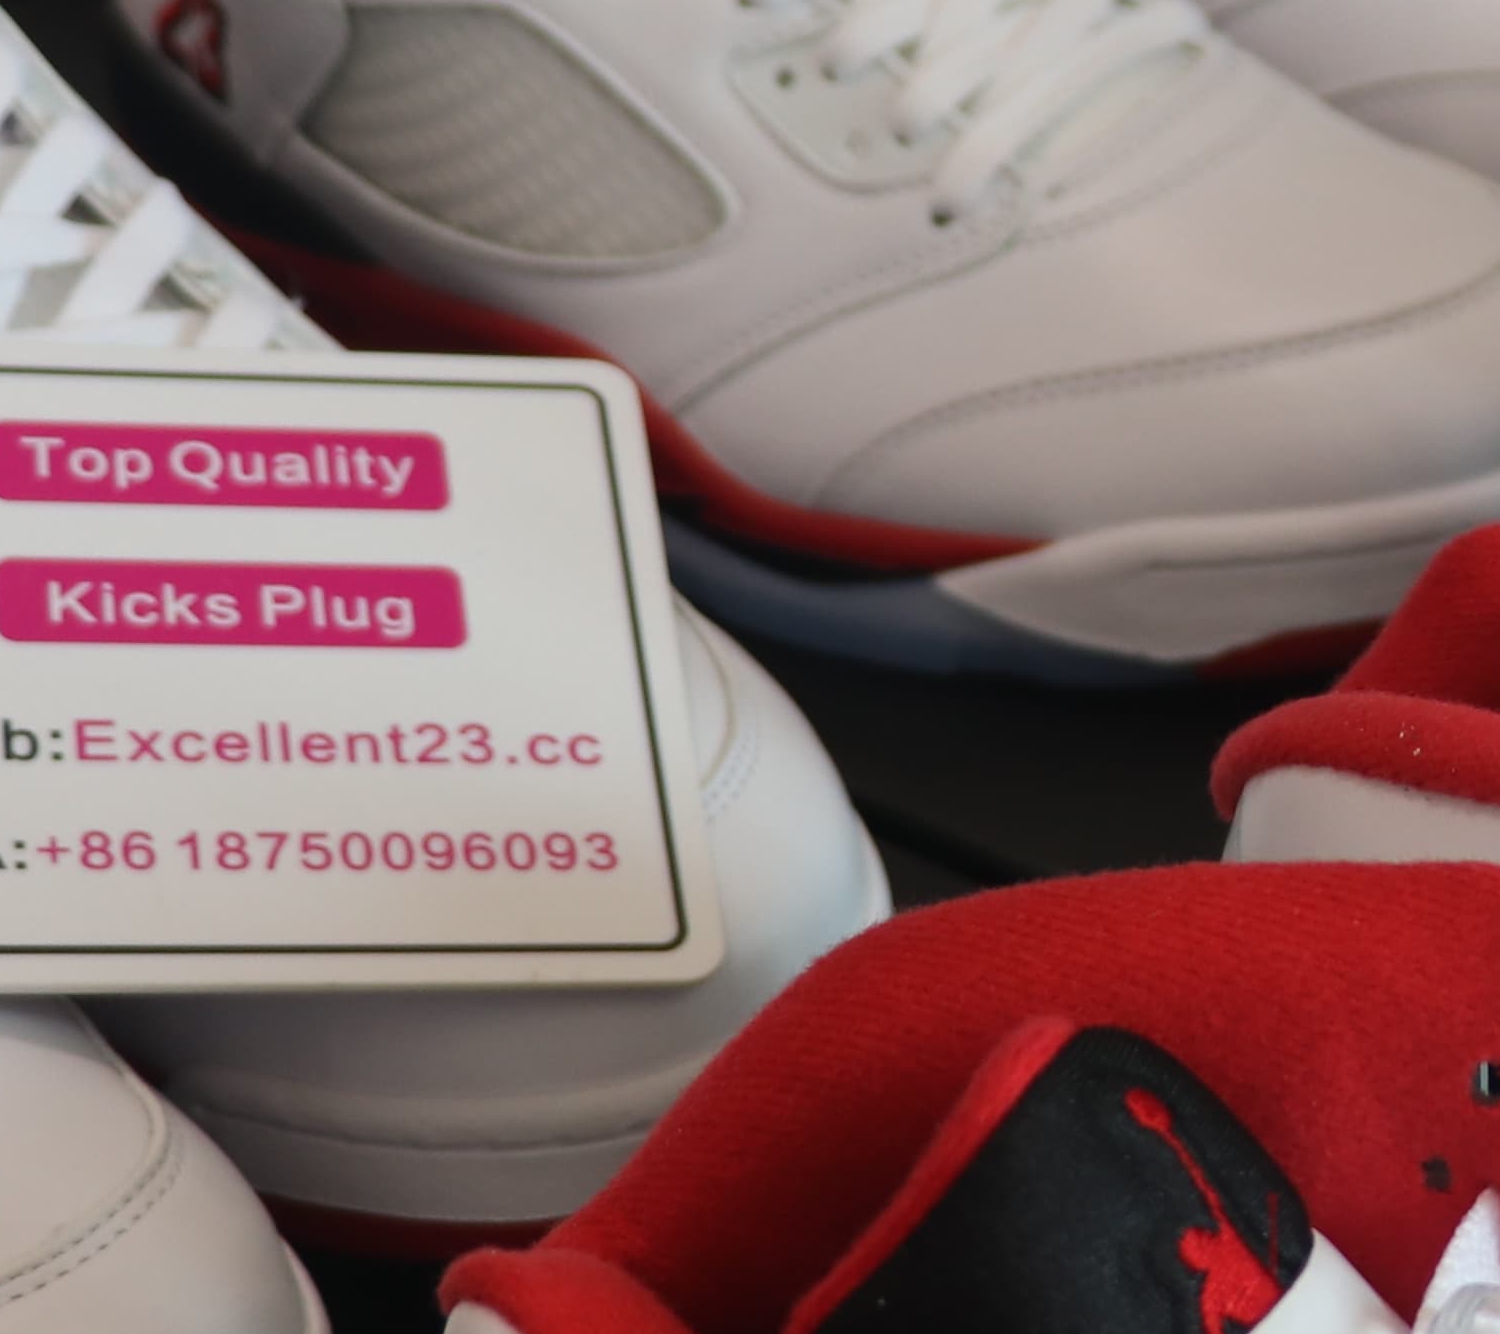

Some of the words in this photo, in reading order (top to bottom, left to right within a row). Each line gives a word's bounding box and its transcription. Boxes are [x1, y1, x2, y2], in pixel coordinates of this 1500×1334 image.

[19, 435, 154, 491] Top
[168, 439, 415, 498] Quality
[46, 579, 242, 627] Kicks
[259, 584, 416, 639] Plug
